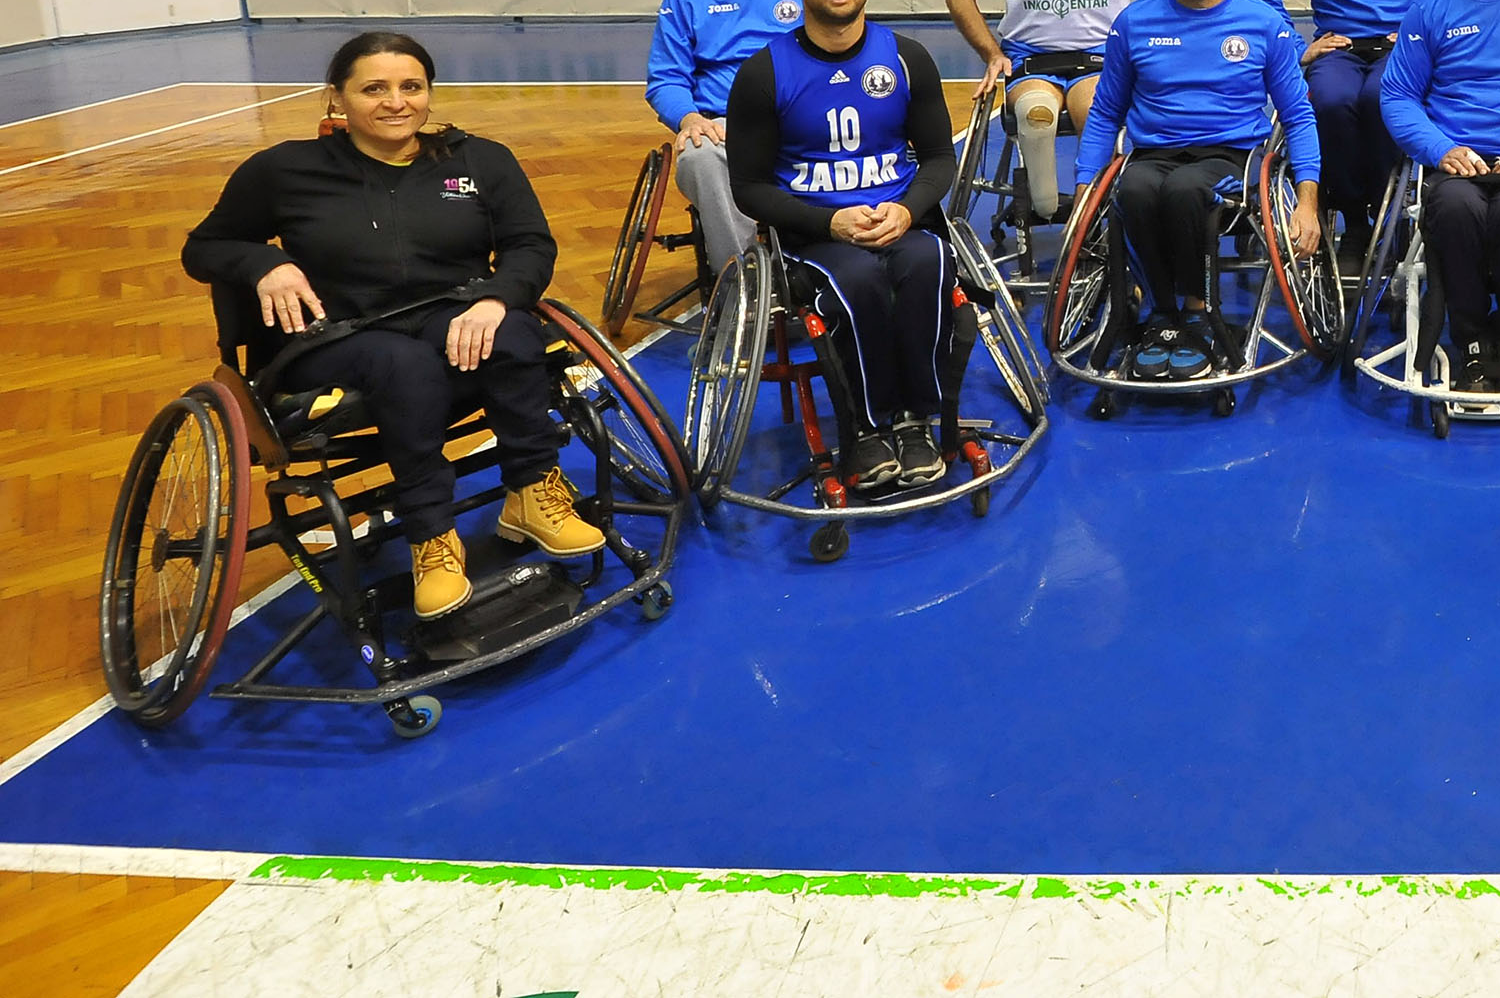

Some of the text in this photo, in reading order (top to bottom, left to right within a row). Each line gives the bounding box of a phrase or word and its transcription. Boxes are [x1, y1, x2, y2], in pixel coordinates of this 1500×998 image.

[1023, 0, 1050, 11] INKO
[826, 106, 860, 152] 10
[790, 153, 900, 192] ZADAR
[309, 577, 323, 593] Pro
